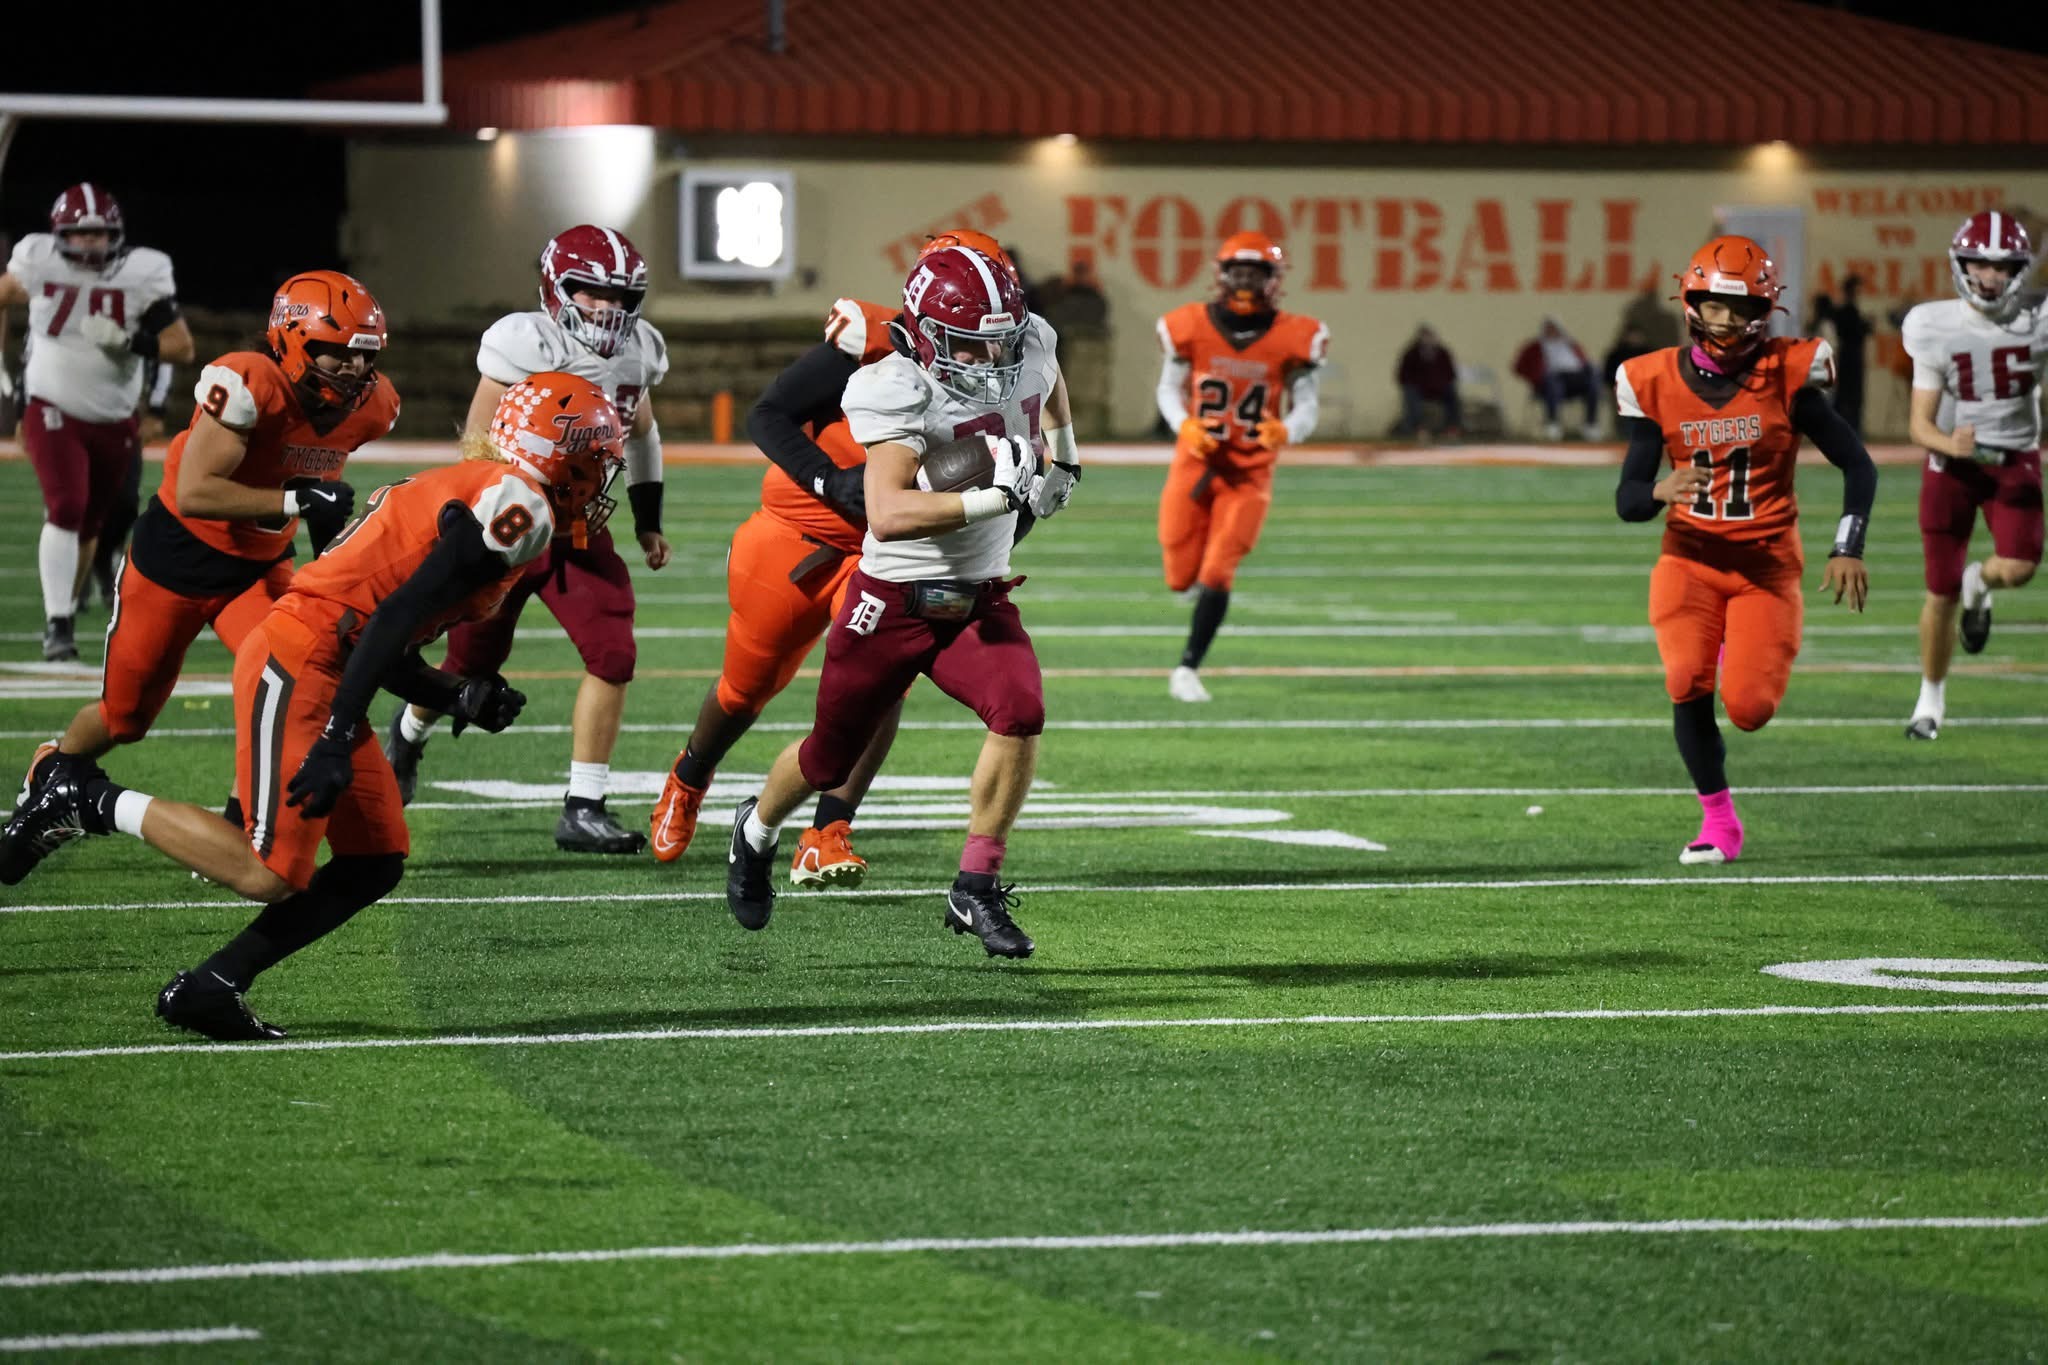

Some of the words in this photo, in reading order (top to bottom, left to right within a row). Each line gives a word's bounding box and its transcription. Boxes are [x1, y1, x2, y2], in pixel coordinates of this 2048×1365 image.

[1813, 187, 2004, 215] WELCOME
[1062, 195, 1663, 293] FOOTBALL
[1877, 225, 1916, 245] TO
[1813, 257, 1956, 300] ARLI
[1952, 345, 2036, 402] 16
[206, 384, 230, 420] 9
[1197, 378, 1271, 442] 24
[1680, 415, 1762, 446] TYGERS
[1689, 445, 1755, 520] 11
[489, 503, 534, 547] 8
